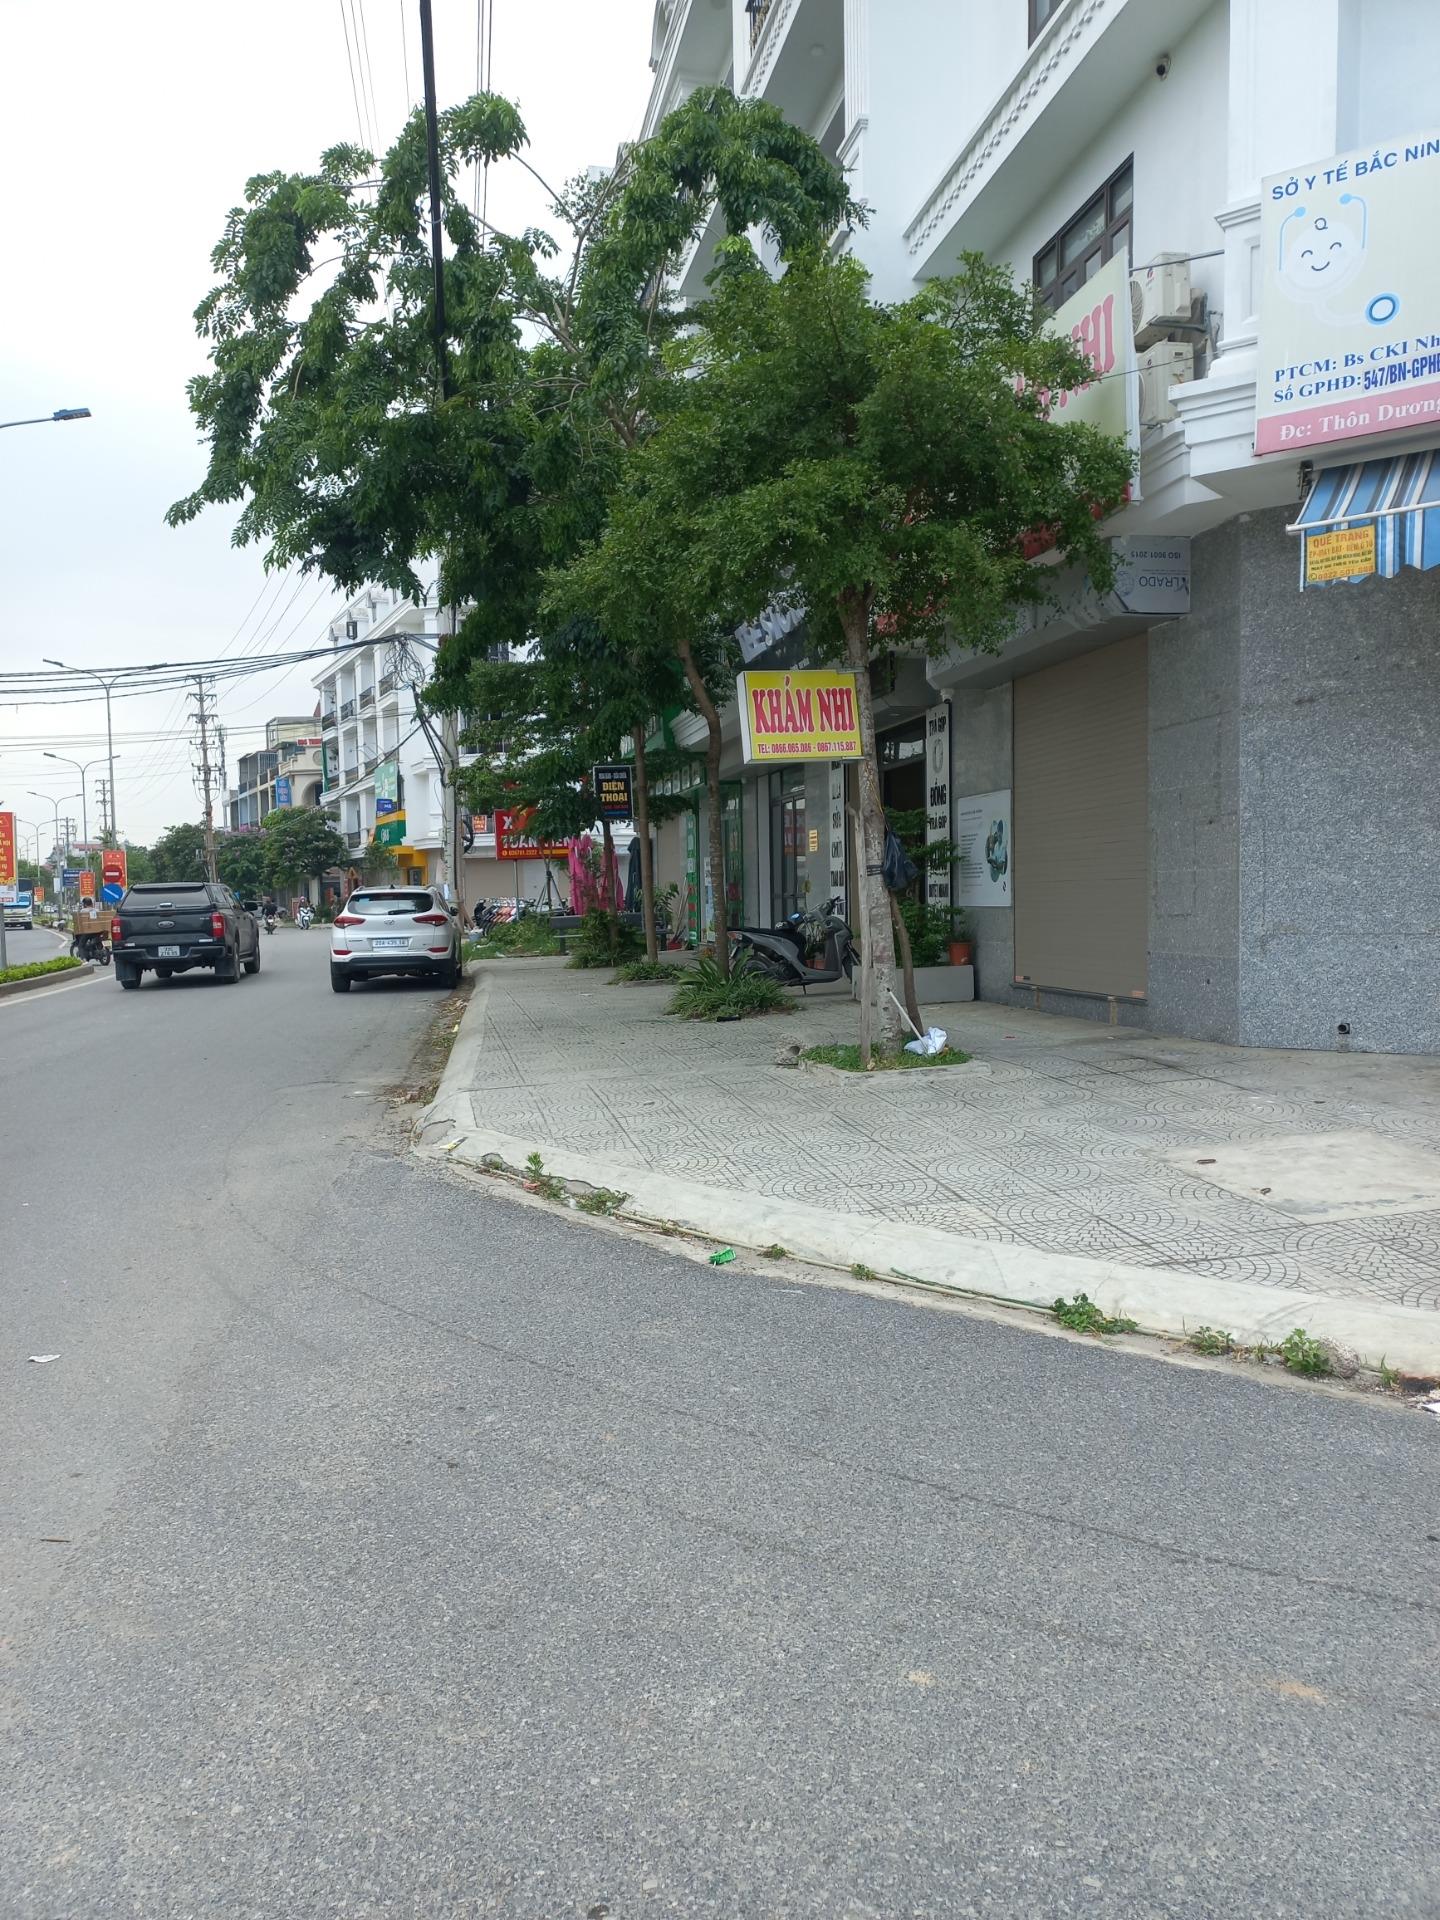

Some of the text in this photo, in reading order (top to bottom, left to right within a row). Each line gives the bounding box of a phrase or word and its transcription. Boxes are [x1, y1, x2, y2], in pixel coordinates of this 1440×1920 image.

[1272, 176, 1299, 200] SỞ
[1305, 175, 1317, 190] Y
[1323, 159, 1349, 185] TẾ
[1355, 150, 1398, 177] BẮC
[1275, 358, 1337, 383] PTCM:
[1344, 353, 1364, 368] Bs
[1370, 341, 1408, 361] CKI
[1274, 384, 1294, 403] Số
[1299, 375, 1361, 398] GPHĐ:
[1280, 423, 1311, 441] Đc:
[1319, 411, 1370, 433] Thôn
[817, 687, 856, 732] NHI
